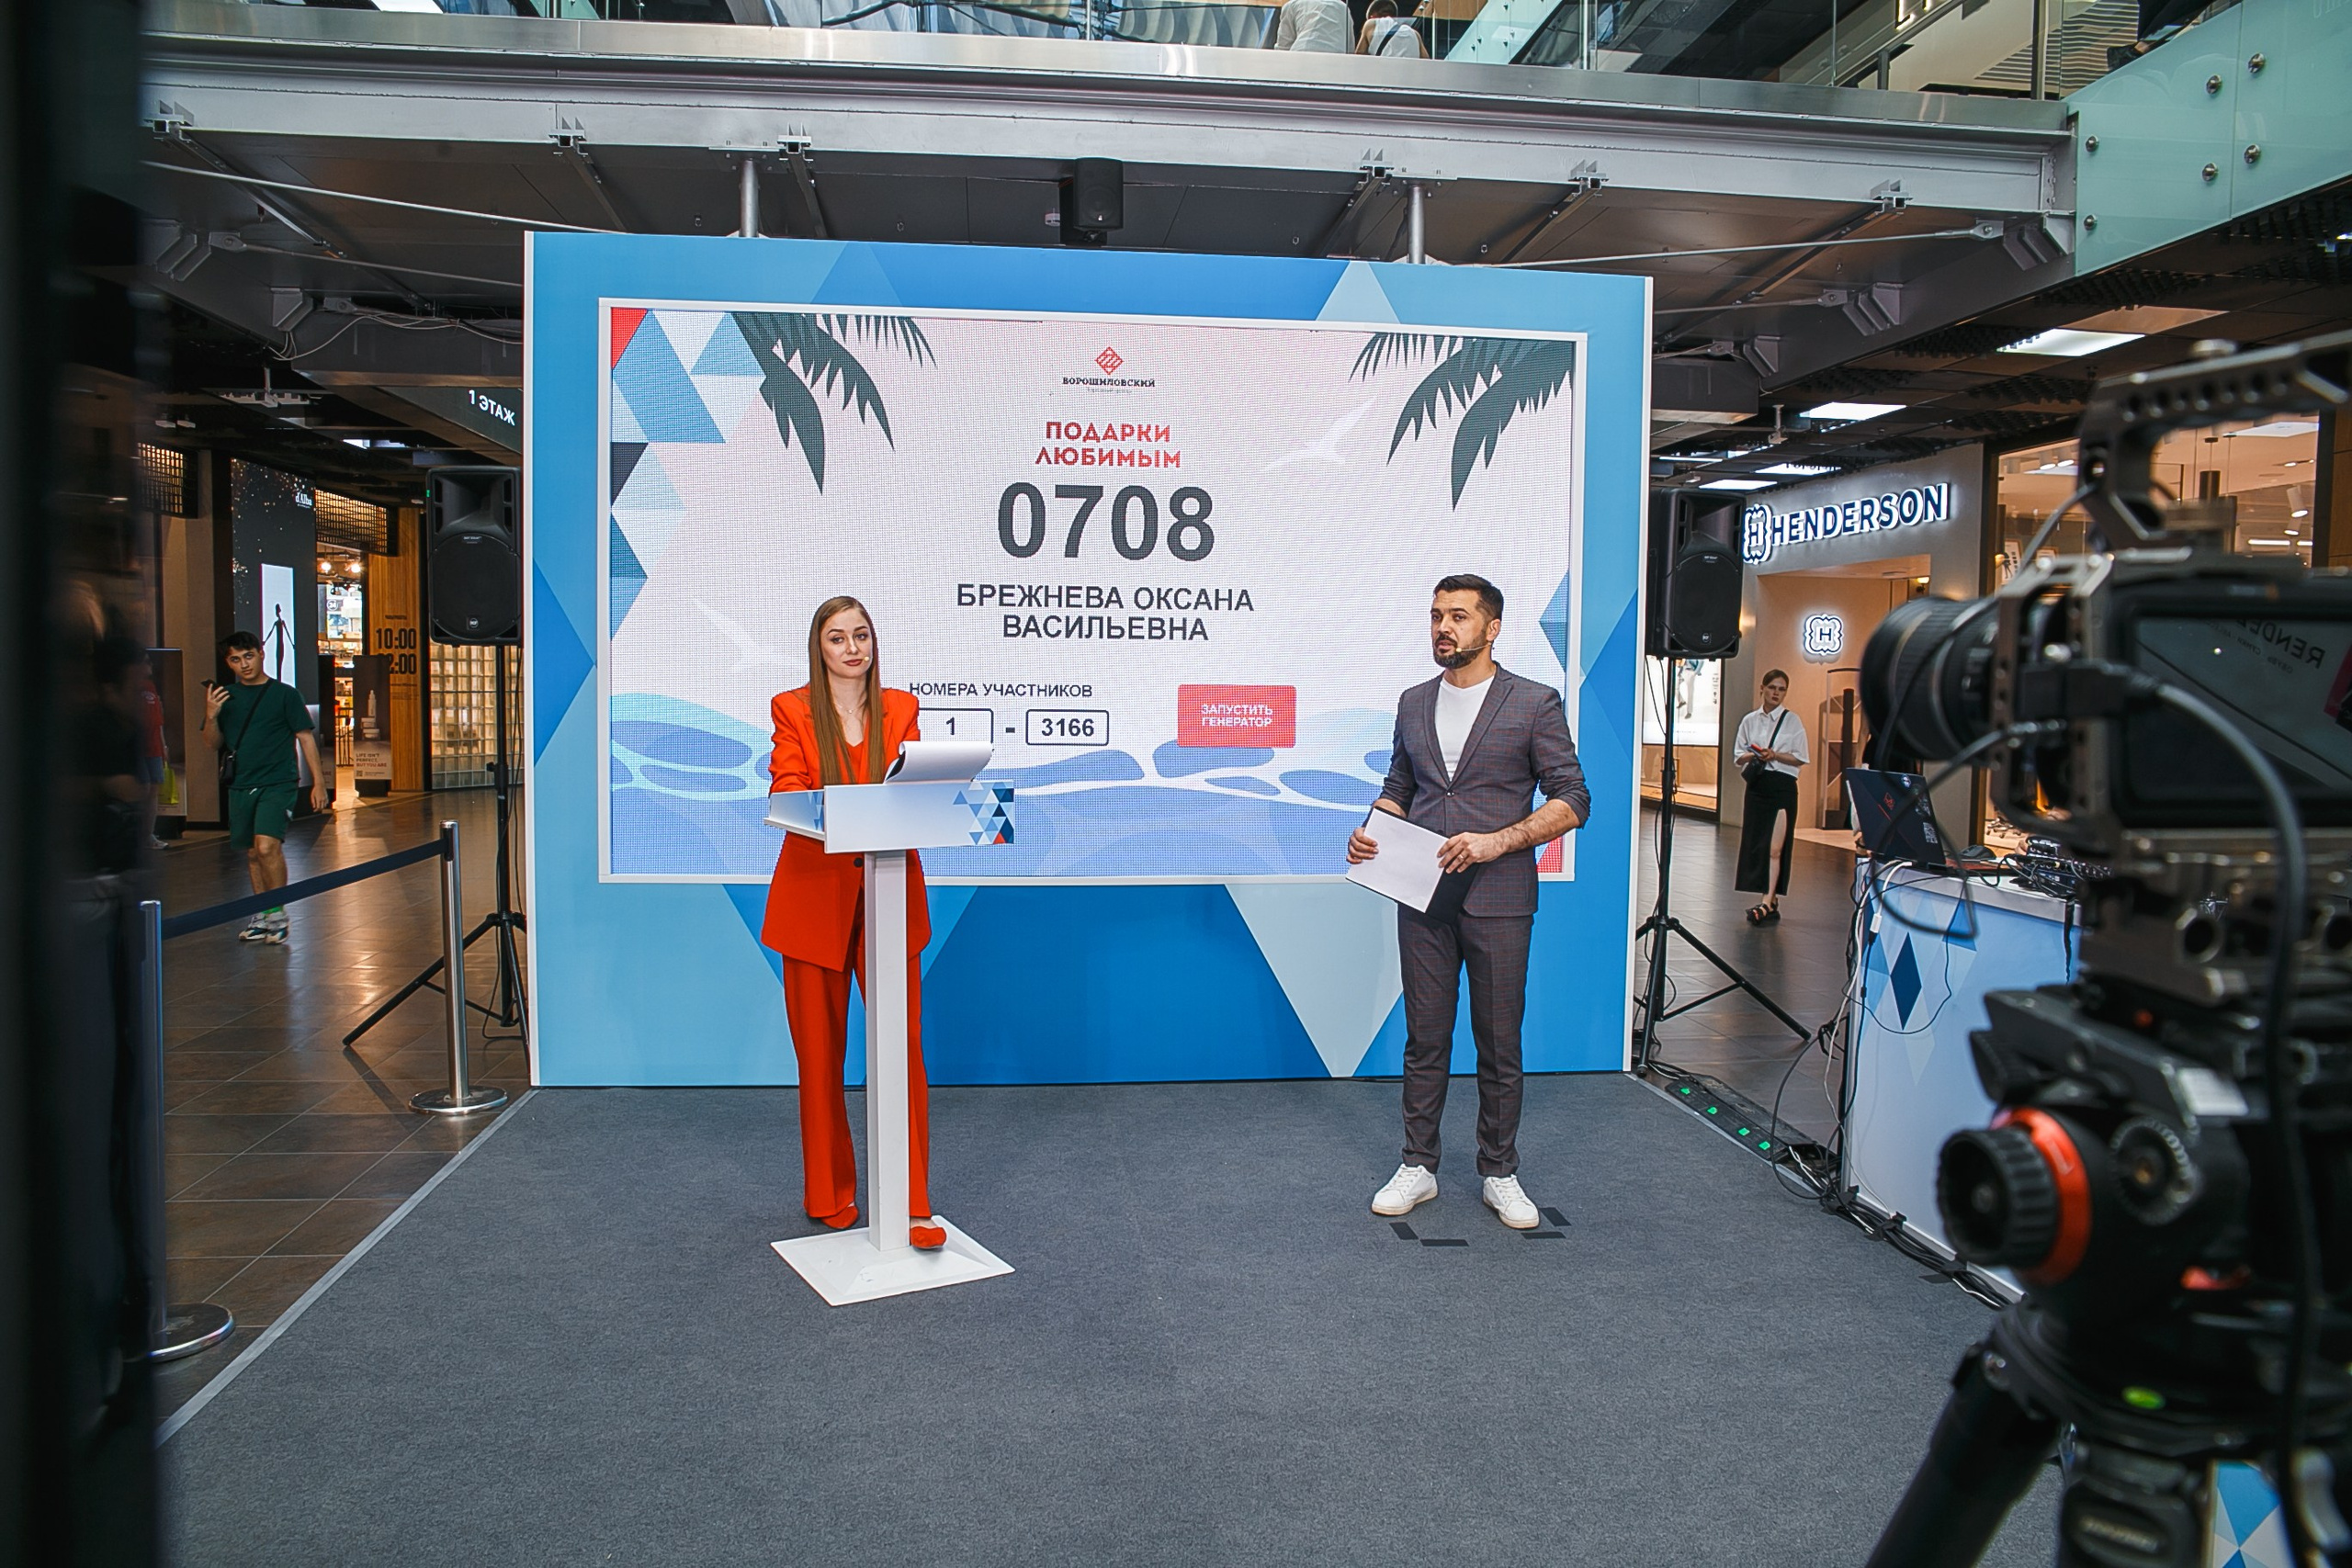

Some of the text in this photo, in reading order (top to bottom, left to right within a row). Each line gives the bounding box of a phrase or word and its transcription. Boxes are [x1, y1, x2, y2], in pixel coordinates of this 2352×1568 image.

[1062, 377, 1155, 387] ВОРОШИЛОВСКИЙ
[469, 389, 515, 426] 1 ЭТАЖ
[1046, 422, 1170, 443] ПОДАРКИ
[1035, 446, 1181, 468] ЛЮБИМЫМ
[998, 482, 1215, 560] 0708
[1771, 483, 1948, 546] HENDERSON
[956, 583, 1254, 611] БРЕЖНЕВА ОКСАНА
[1003, 615, 1209, 640] ВАСИЛЬЕВНА
[376, 628, 416, 649] 10:00
[378, 653, 416, 674] 2:00
[910, 682, 1092, 697] НОМЕРА УЧАСТНИКОВ
[1201, 704, 1272, 715] ЗАПУСТИТЬ
[945, 717, 956, 735] 1
[1041, 718, 1094, 737] 3166
[1201, 716, 1272, 727] ГЕНЕРАТОР
